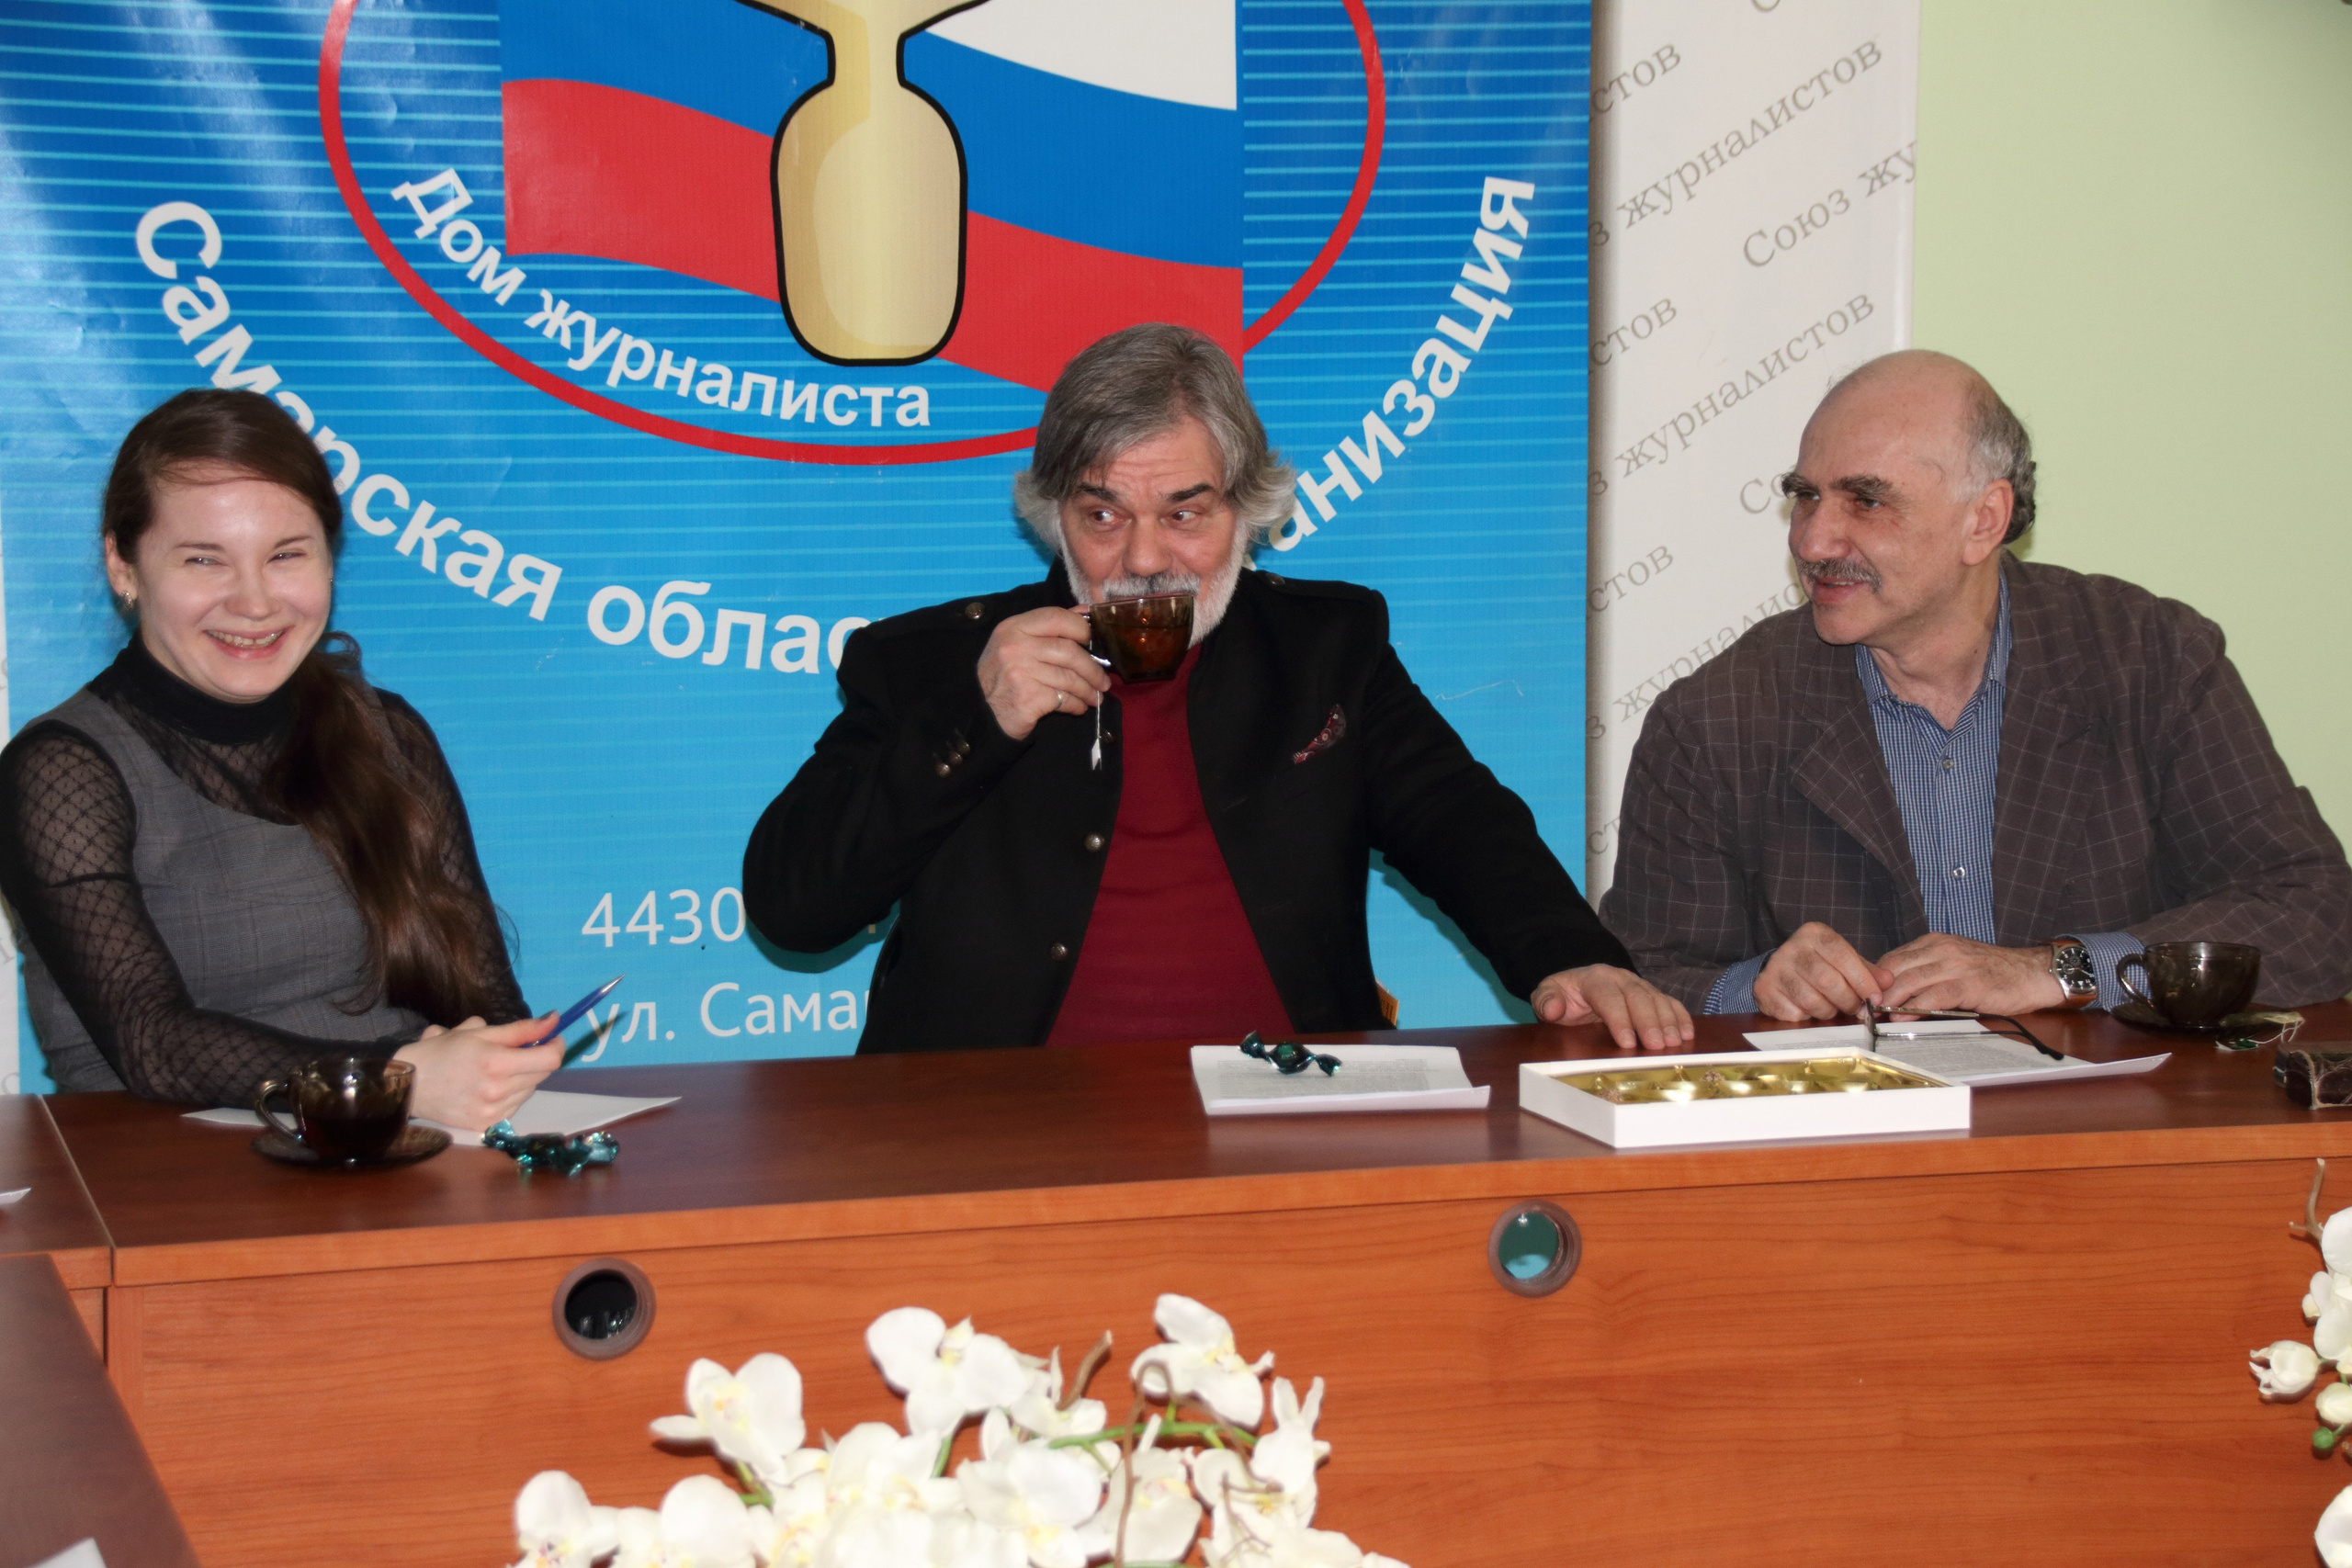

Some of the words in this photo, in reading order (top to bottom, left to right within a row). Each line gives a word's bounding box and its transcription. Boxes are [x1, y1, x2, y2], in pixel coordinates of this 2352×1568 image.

[1589, 44, 1680, 123] стов
[1617, 41, 1882, 228] журналистов
[1743, 189, 1850, 267] Союз
[390, 168, 526, 306] Дом
[524, 288, 931, 427] журналиста
[1589, 298, 1678, 373] стов
[587, 580, 886, 674] облас
[1241, 175, 1535, 571] анизация
[1615, 294, 1874, 478] журналистов
[1588, 546, 1674, 619] стов
[581, 886, 746, 948] 4430
[581, 1001, 675, 1063] ул.
[700, 982, 870, 1038] Сама
